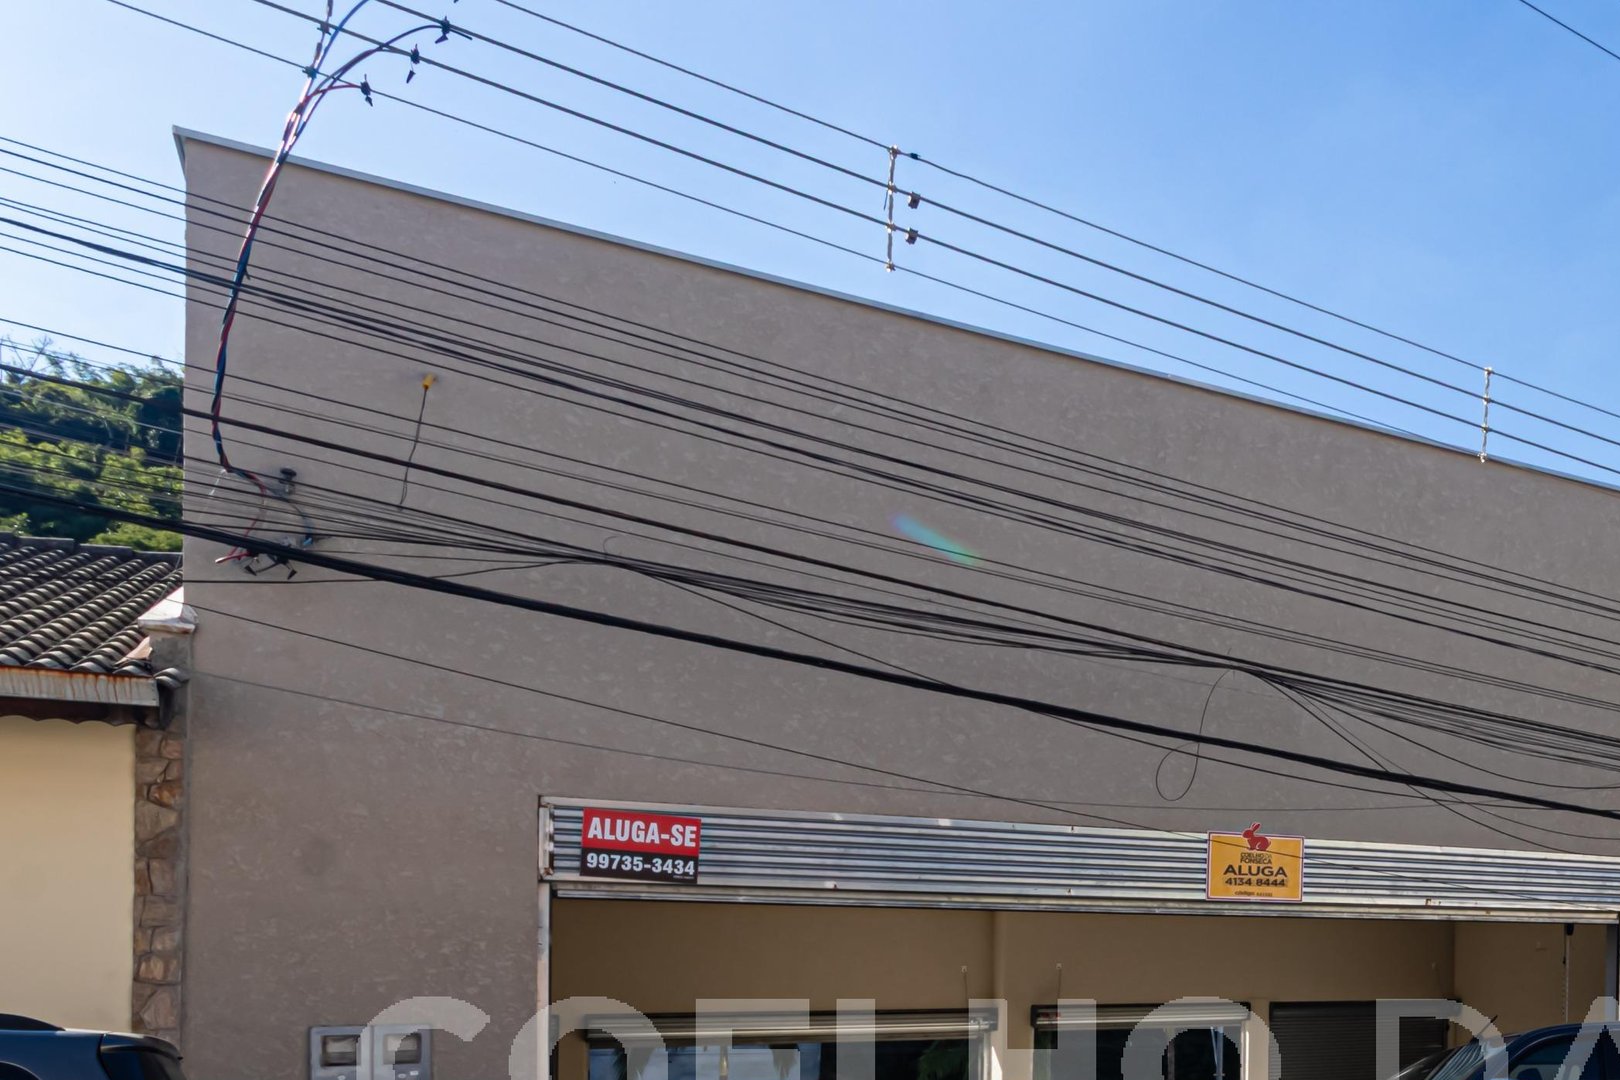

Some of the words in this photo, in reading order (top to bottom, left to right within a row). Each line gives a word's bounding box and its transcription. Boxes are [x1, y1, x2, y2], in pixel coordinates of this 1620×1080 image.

[587, 816, 697, 847] ALUGA-SE
[586, 852, 695, 876] 99735-3434
[1223, 864, 1288, 877] ALUGA
